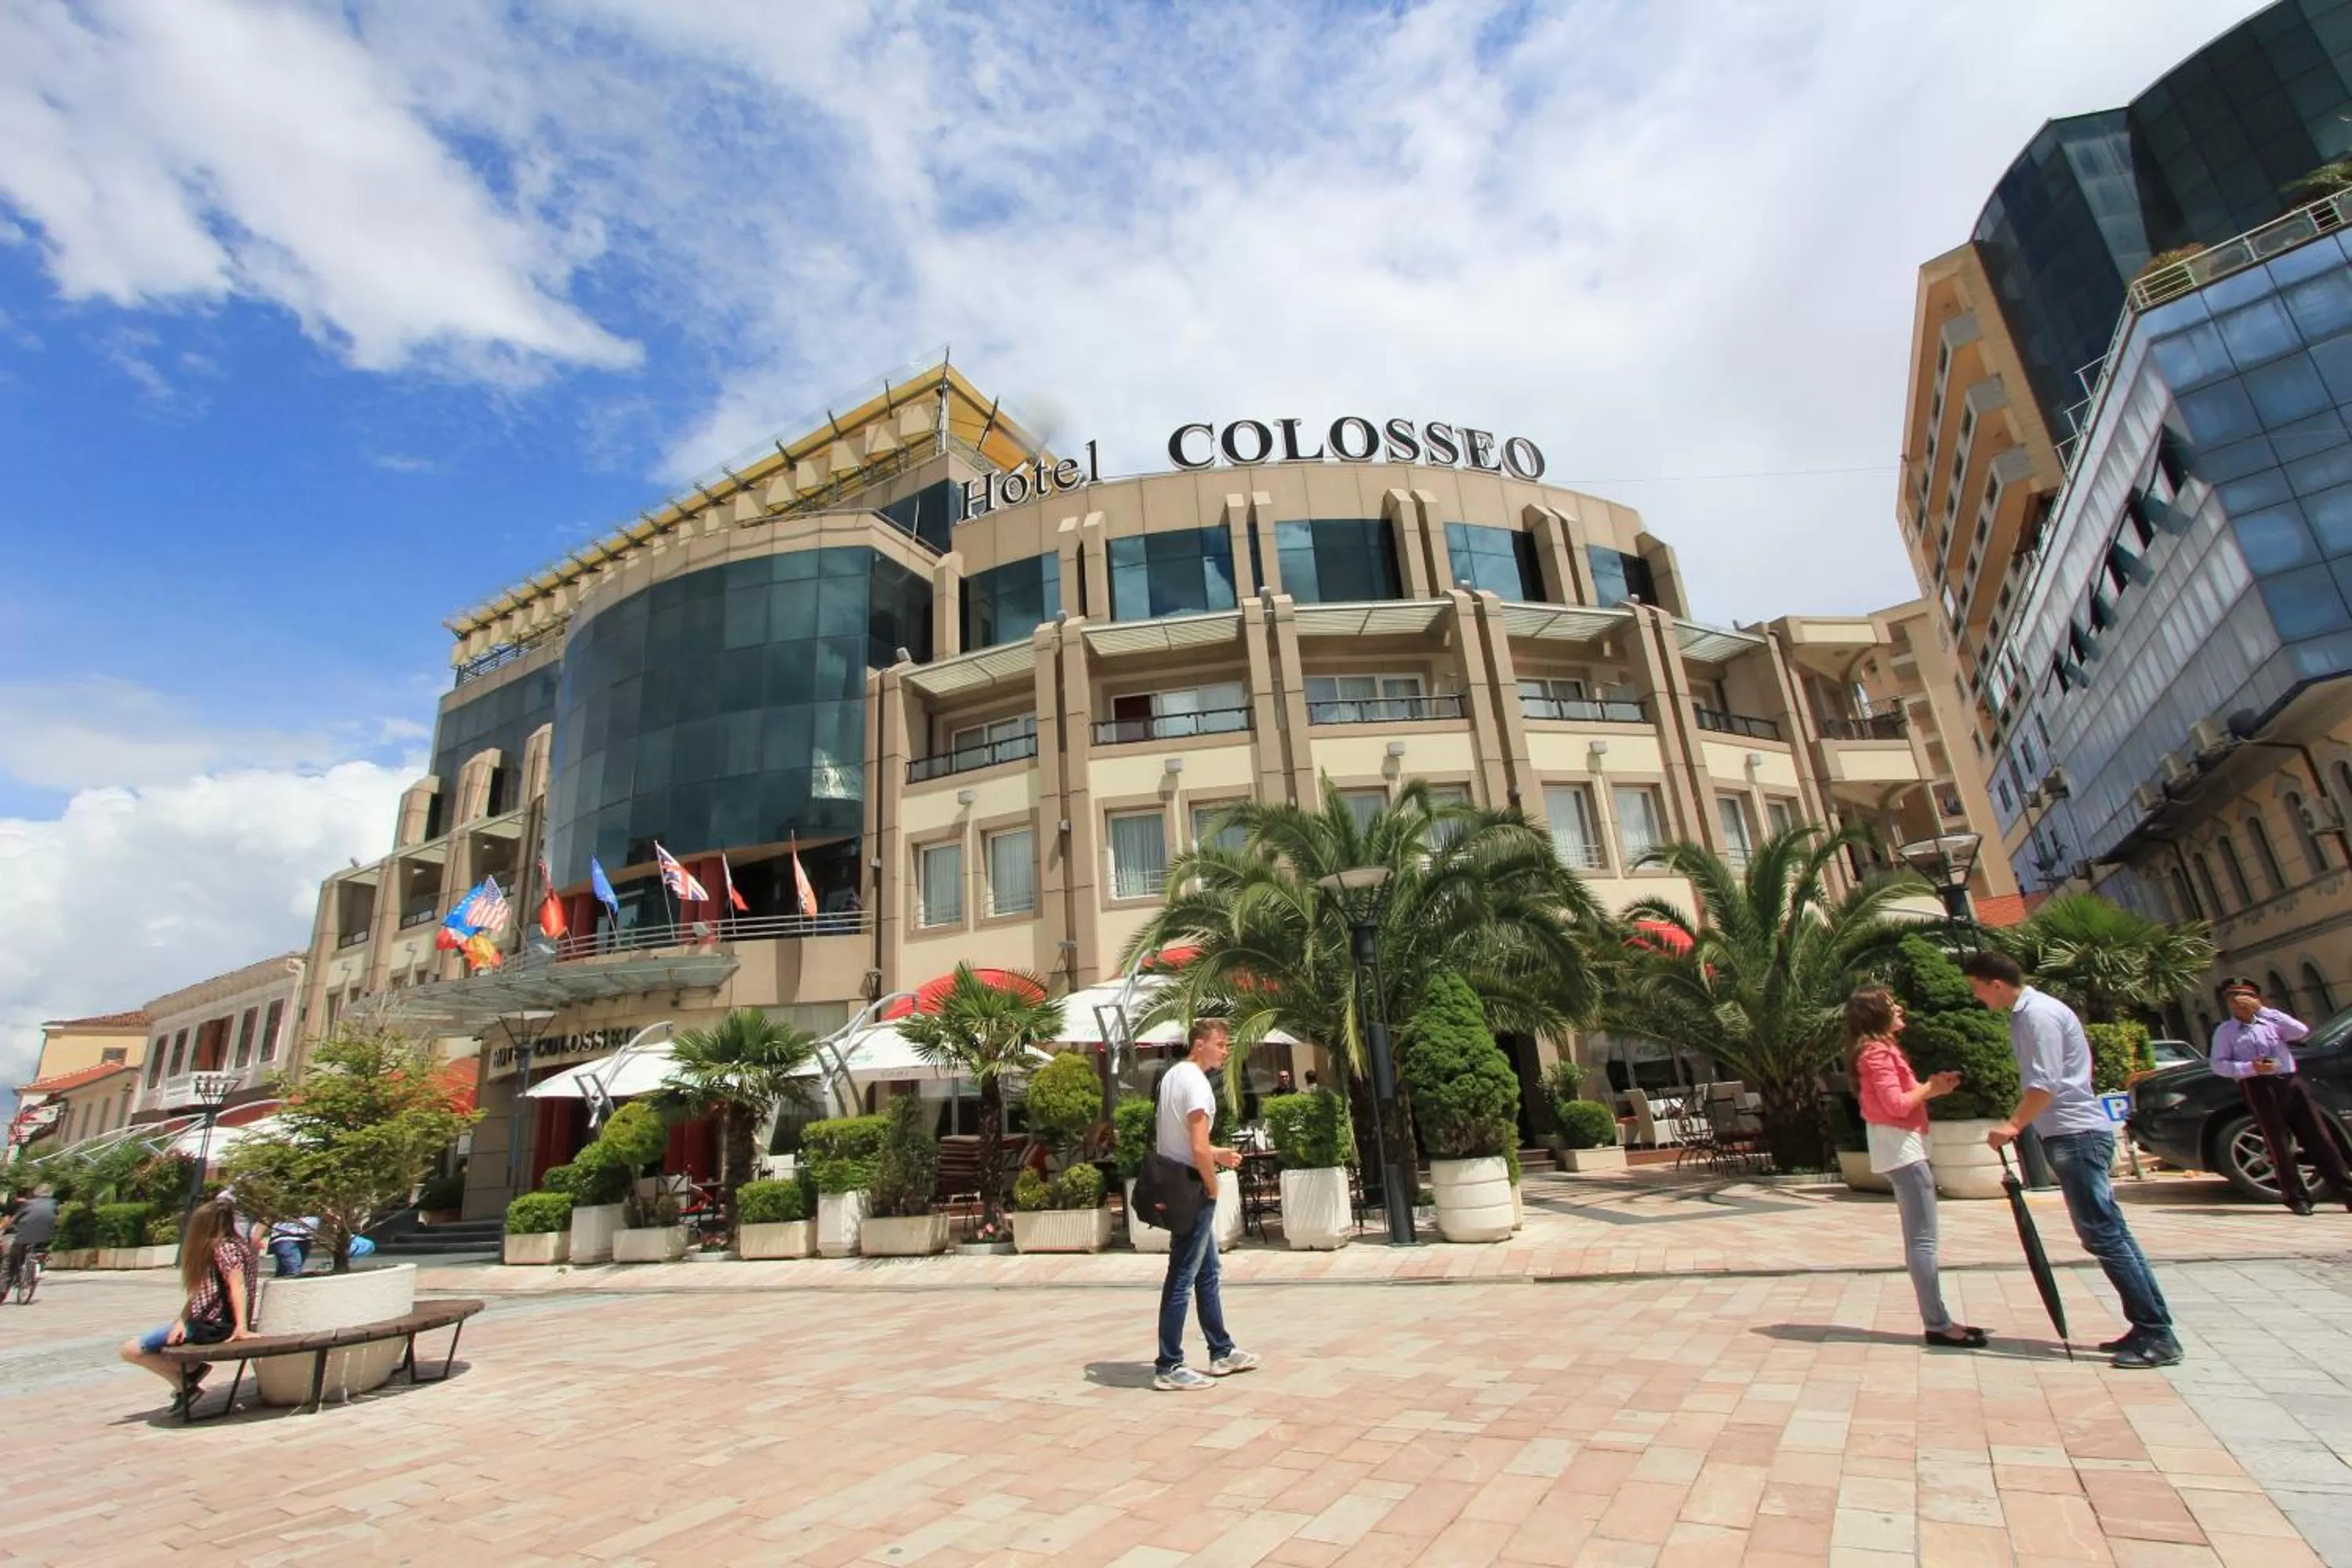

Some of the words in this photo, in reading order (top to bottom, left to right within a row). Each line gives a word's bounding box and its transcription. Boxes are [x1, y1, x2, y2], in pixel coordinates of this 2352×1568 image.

[956, 439, 1104, 524] Hotel
[1167, 416, 1545, 481] COLOSSEO
[2107, 1098, 2128, 1119] P
